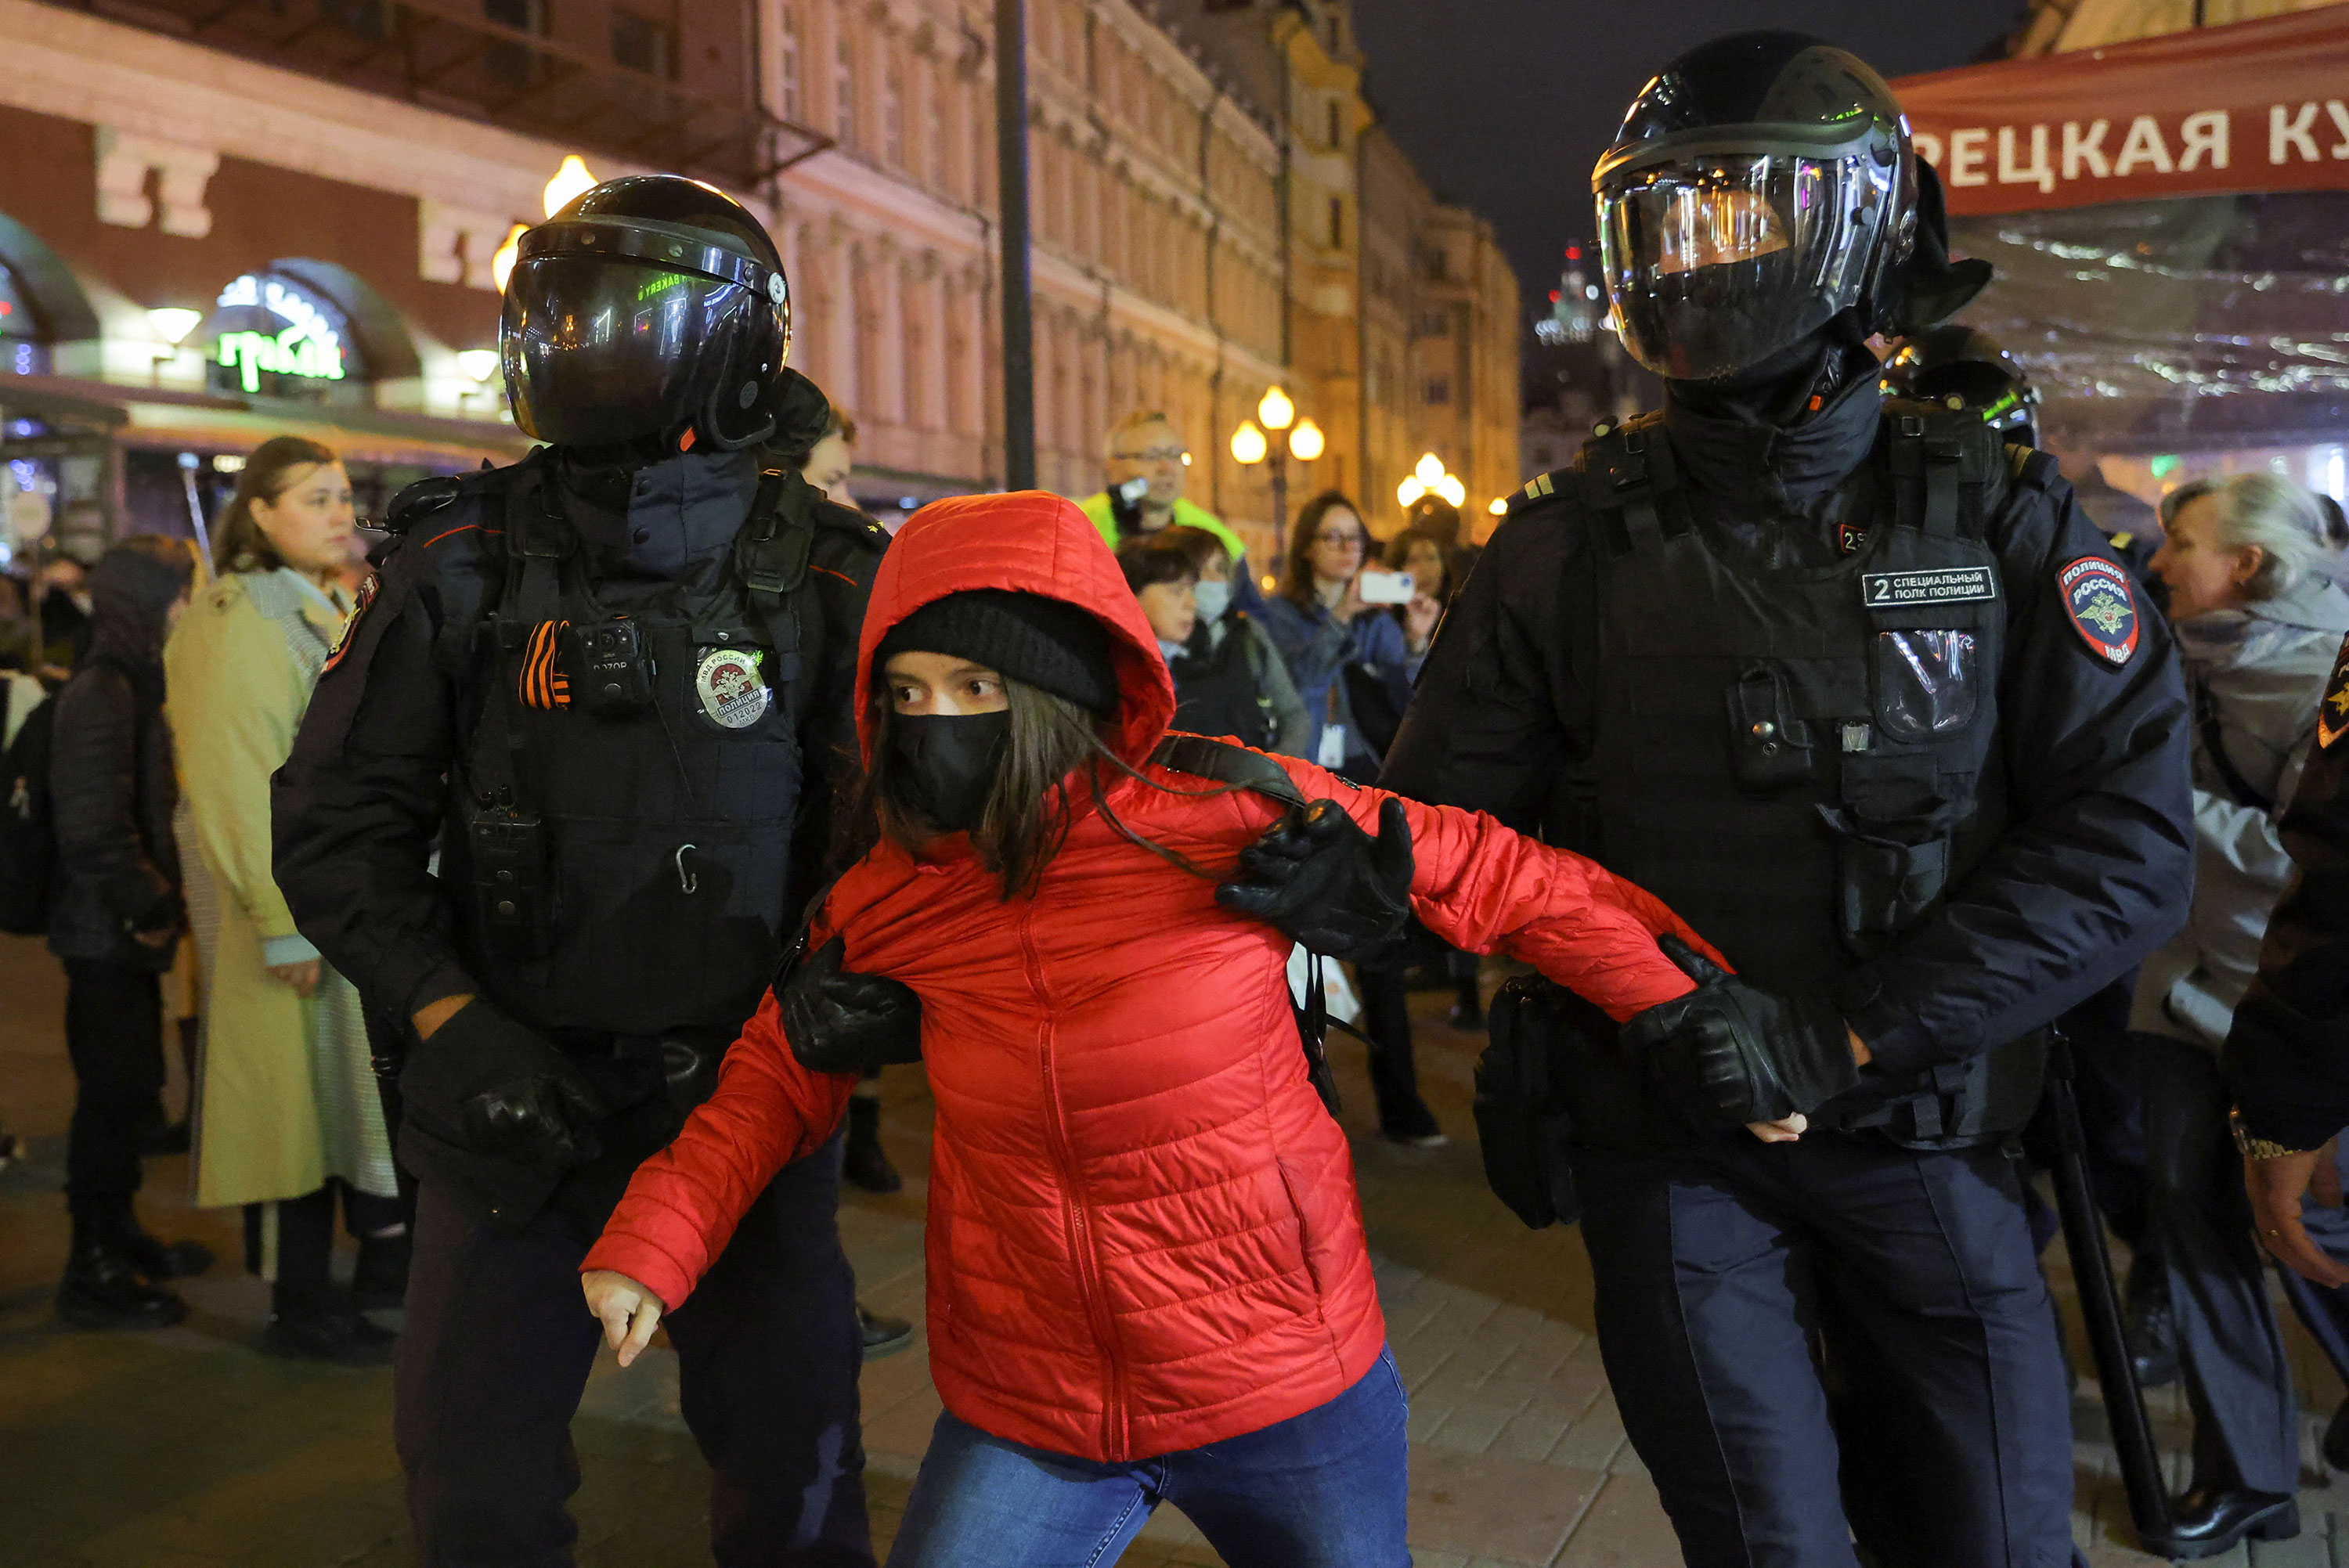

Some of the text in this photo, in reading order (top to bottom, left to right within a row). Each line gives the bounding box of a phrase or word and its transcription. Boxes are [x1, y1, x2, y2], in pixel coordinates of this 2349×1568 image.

[1845, 532, 1856, 550] 2
[1893, 572, 1983, 588] СПЕЦИАЛЬНЫЙ
[2063, 561, 2124, 586] ПОЛИЦИЯ
[1875, 579, 1890, 600] 2
[1895, 585, 1985, 599] ПОЛК ПОЛИЦИИ
[2073, 579, 2127, 605] РОССИЯ
[2105, 643, 2131, 663] МВД
[701, 654, 746, 683] МВД РОССИИ
[718, 690, 760, 716] ПОЛИЦИЯ
[727, 702, 762, 723] 012022
